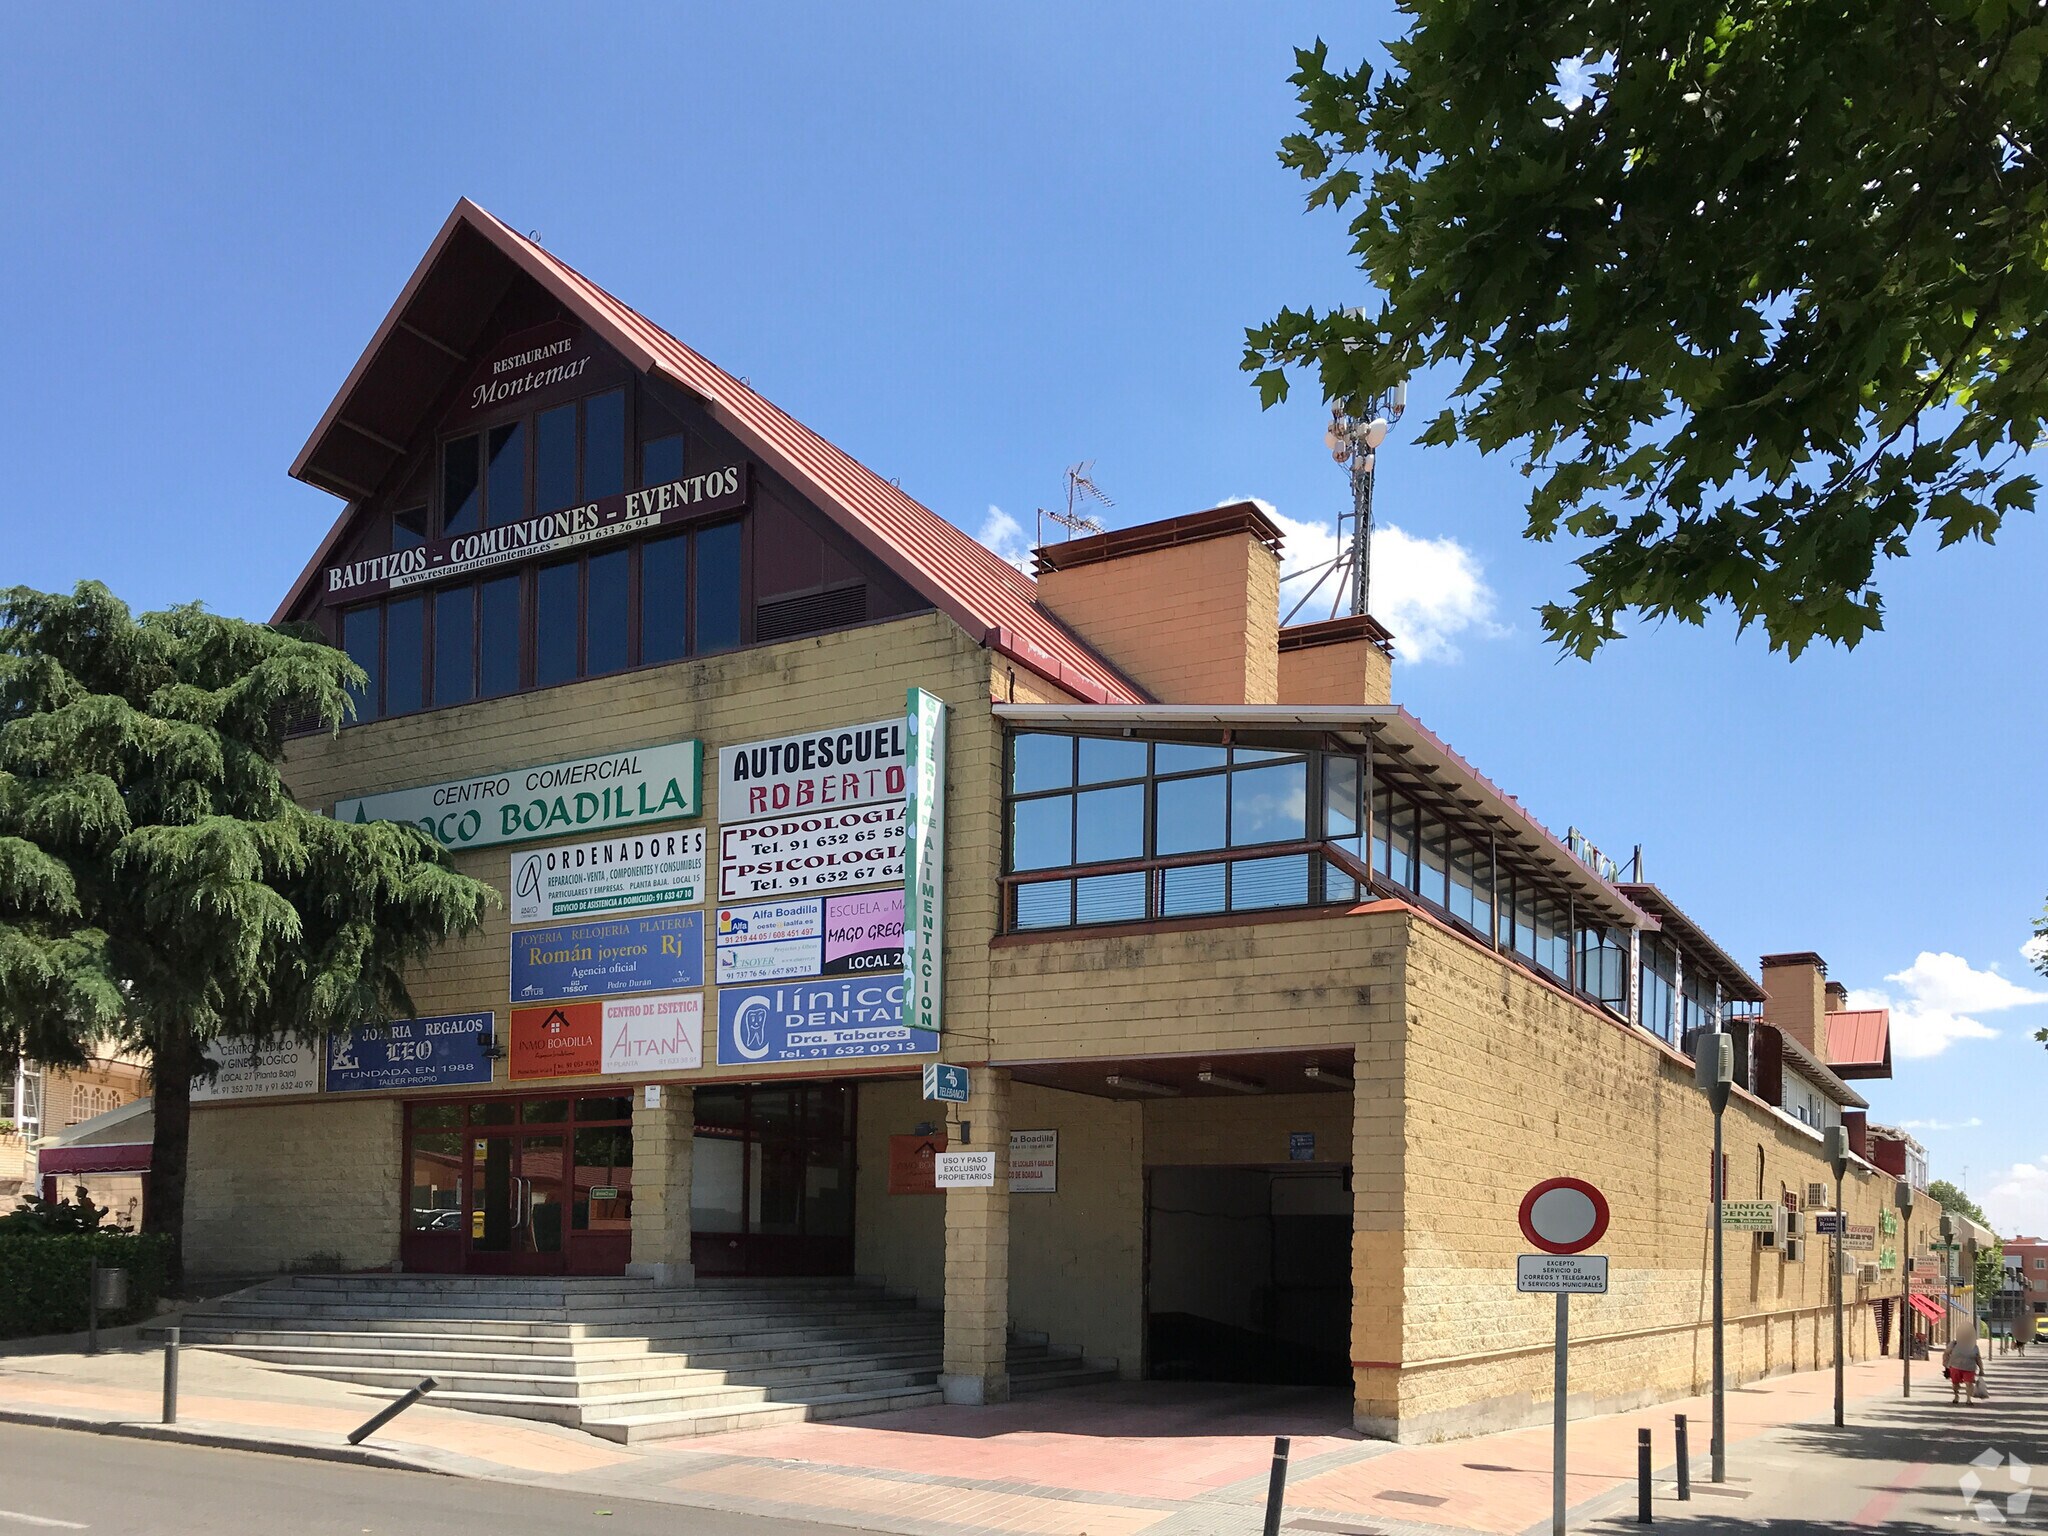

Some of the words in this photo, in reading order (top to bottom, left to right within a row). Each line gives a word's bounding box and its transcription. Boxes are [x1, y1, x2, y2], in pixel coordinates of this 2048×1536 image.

[493, 338, 572, 374] RESTAURANTE
[471, 356, 591, 409] Montemar
[328, 547, 427, 592] BAUTIZOS
[450, 503, 599, 563] COMUNIONES
[625, 466, 738, 520] EVENTOS
[401, 541, 551, 585] www.restaurantemontemar.es
[579, 531, 591, 543] 91
[596, 525, 615, 539] 633
[618, 522, 632, 534] 26
[635, 517, 649, 528] 94
[733, 725, 905, 782] AUTOESCUEL
[432, 777, 511, 807] CENTRO
[526, 756, 642, 792] COMERCIAL
[750, 765, 906, 815] ROBERTO
[500, 777, 688, 836] BOADILLA
[751, 841, 784, 856] Tel.
[790, 839, 809, 851] 91
[816, 833, 849, 847] 632
[854, 829, 876, 842] 65
[883, 825, 905, 838] 58
[547, 832, 702, 871] ORDENADORES
[610, 864, 653, 880] COMPONENTES
[660, 858, 702, 874] CONSUMIBLES
[751, 875, 782, 892] Tel.
[789, 876, 808, 887] 91
[815, 870, 849, 884] 632
[854, 867, 876, 879] 67
[882, 863, 904, 876] 64
[548, 887, 588, 899] PARTICULARES
[629, 880, 652, 890] PLANTA
[673, 875, 691, 885] LOCAL
[693, 874, 700, 882] 15
[554, 902, 579, 913] SERVICIO
[579, 901, 586, 910] DE
[587, 898, 618, 909] ASISTENCIA
[623, 894, 656, 905] DOMICILIO:
[656, 892, 663, 900] 91
[664, 891, 675, 899] 633
[685, 889, 692, 897] 10
[830, 901, 881, 918] ESCUELA
[752, 909, 773, 919] Alfa
[776, 904, 818, 917] Boadilla
[520, 932, 563, 948] JOYERIA
[572, 924, 630, 940] RELOJERIA
[639, 917, 694, 933] PLATERIA
[724, 936, 733, 944] 91
[735, 935, 748, 943] 219
[758, 932, 768, 940] 05
[772, 930, 786, 939] 608
[786, 929, 800, 937] 451
[801, 927, 814, 936] 497
[732, 922, 748, 931] Alfa
[827, 926, 864, 943] MAGO
[921, 834, 934, 1027] ALIMENTACION
[528, 943, 592, 966] Román
[598, 944, 648, 962] joyeros
[660, 933, 682, 959] Rj
[571, 965, 606, 979] Agencia
[609, 961, 637, 974] oficial
[771, 967, 784, 976] 657
[785, 966, 798, 974] 892
[799, 965, 812, 973] 713
[848, 954, 890, 970] LOCAL
[521, 987, 544, 997] LOTUS
[562, 984, 588, 993] TISSOT
[607, 980, 627, 989] Pedro
[607, 1004, 642, 1019] CENTRO
[642, 1003, 655, 1016] DE
[657, 1000, 698, 1015] ESTETICA
[785, 1007, 904, 1029] DENTAL
[362, 1025, 412, 1041] JORIA
[425, 1019, 483, 1036] REGALOS
[790, 1034, 828, 1045] Dra.
[834, 1027, 907, 1042] Tabares
[221, 1043, 255, 1056] CENTRO
[385, 1039, 432, 1063] LEO
[547, 1035, 593, 1049] BOADILLA
[778, 1049, 805, 1059] Tel.
[810, 1047, 828, 1057] 91
[834, 1044, 865, 1055] 632
[870, 1043, 890, 1053] 09
[897, 1042, 916, 1051] 13
[221, 1074, 242, 1083] LOCAL
[244, 1072, 253, 1080] 27
[341, 1068, 411, 1080] FUNDADA
[415, 1065, 436, 1074] EN
[441, 1063, 475, 1073] 1988
[379, 1078, 406, 1086] TALLER
[407, 1075, 438, 1084] PROPIO
[221, 1086, 229, 1094] 91
[231, 1085, 243, 1093] 352
[271, 1082, 279, 1090] 91
[280, 1081, 293, 1089] 632
[304, 1080, 314, 1088] 99
[939, 1086, 965, 1100] TELEBANCO
[1020, 1134, 1054, 1143] Boadilla
[942, 1156, 959, 1164] USO
[966, 1156, 988, 1164] PASO
[944, 1164, 987, 1173] EXCLUSIVO
[938, 1172, 992, 1181] PROPIETARIOS
[1562, 1281, 1603, 1289] MUNICIPALES
